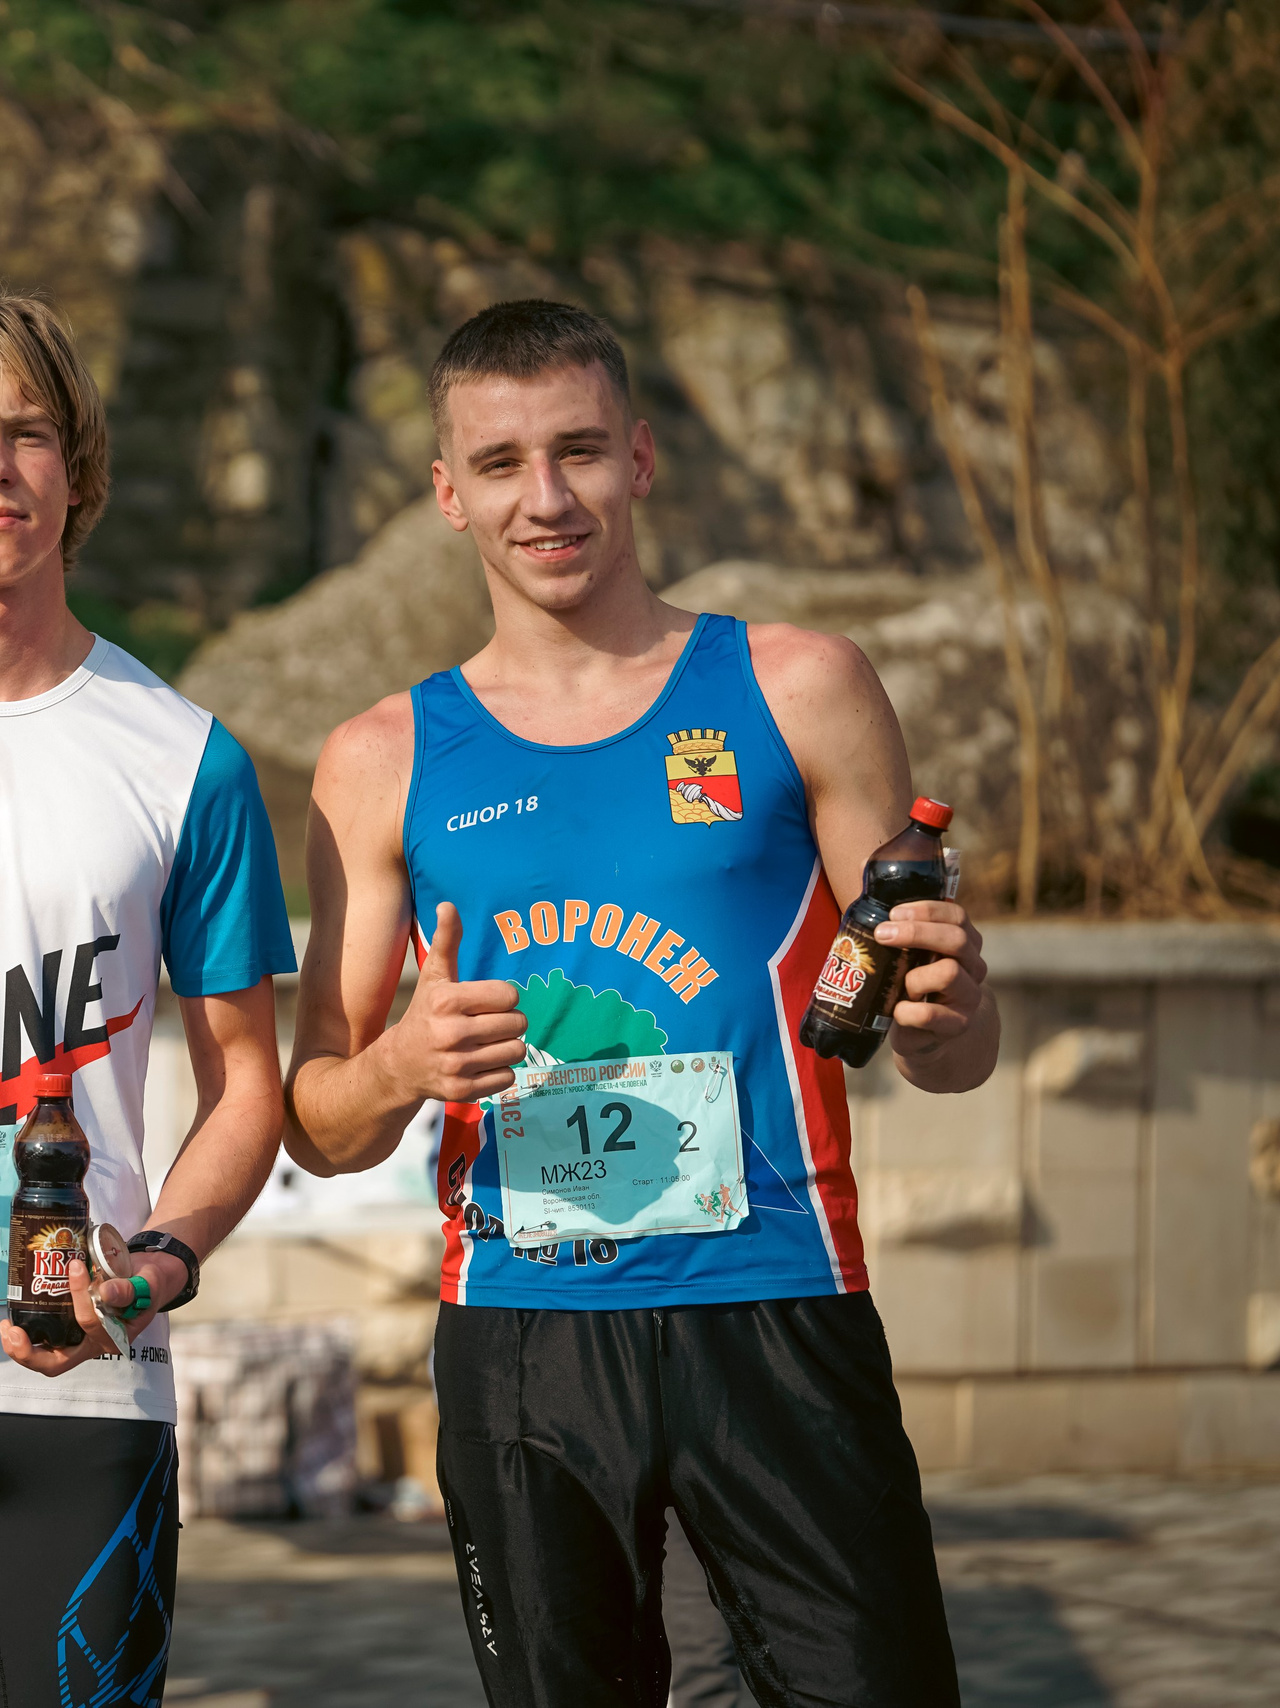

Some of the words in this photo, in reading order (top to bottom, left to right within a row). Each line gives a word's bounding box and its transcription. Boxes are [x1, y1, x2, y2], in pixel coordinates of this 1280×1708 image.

[446, 803, 509, 832] СШОР
[515, 795, 539, 815] 18
[493, 899, 720, 1004] ВОРОНЕЖ
[526, 1066, 597, 1088] ПЕРВЕНСТВО
[599, 1062, 646, 1081] РОССИИ
[620, 1079, 648, 1089] ЧЕЛОВЕКА
[499, 1083, 522, 1123] ЭТА
[503, 1126, 524, 1139] 2
[566, 1102, 636, 1155] 12
[677, 1120, 700, 1153] 2
[541, 1160, 607, 1185] МЖ23
[632, 1178, 654, 1187] Старт
[660, 1174, 691, 1184] 11:05:00
[543, 1195, 586, 1205] Воронежская
[567, 1202, 596, 1212] 8530113
[573, 1238, 619, 1267] 18
